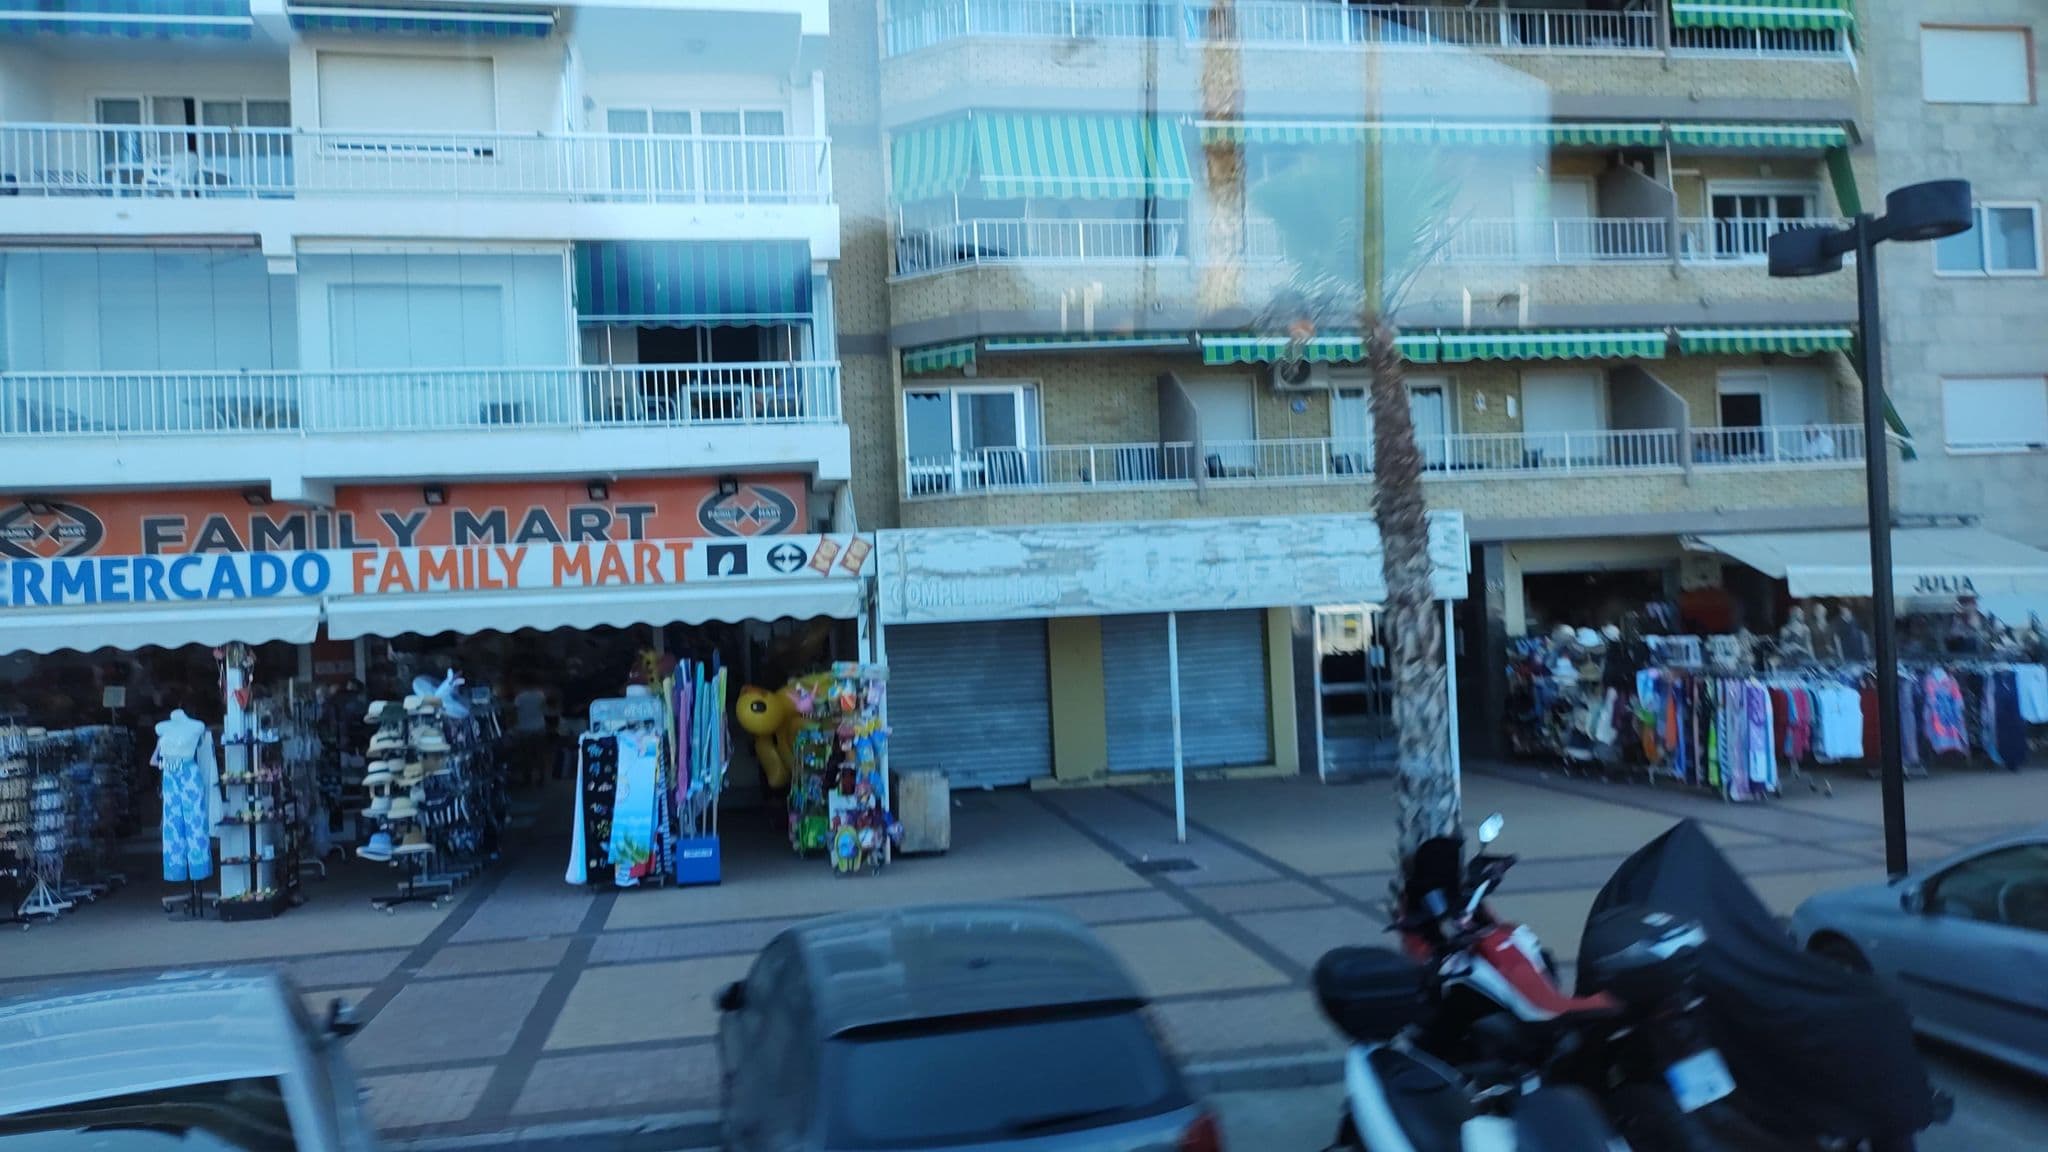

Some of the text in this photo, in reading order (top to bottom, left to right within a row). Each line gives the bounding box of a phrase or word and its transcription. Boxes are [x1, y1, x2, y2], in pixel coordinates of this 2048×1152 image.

[142, 503, 658, 555] FAMILY MART
[352, 543, 528, 593] FAMILY
[552, 541, 694, 589] MART
[1912, 574, 1979, 595] JULIA
